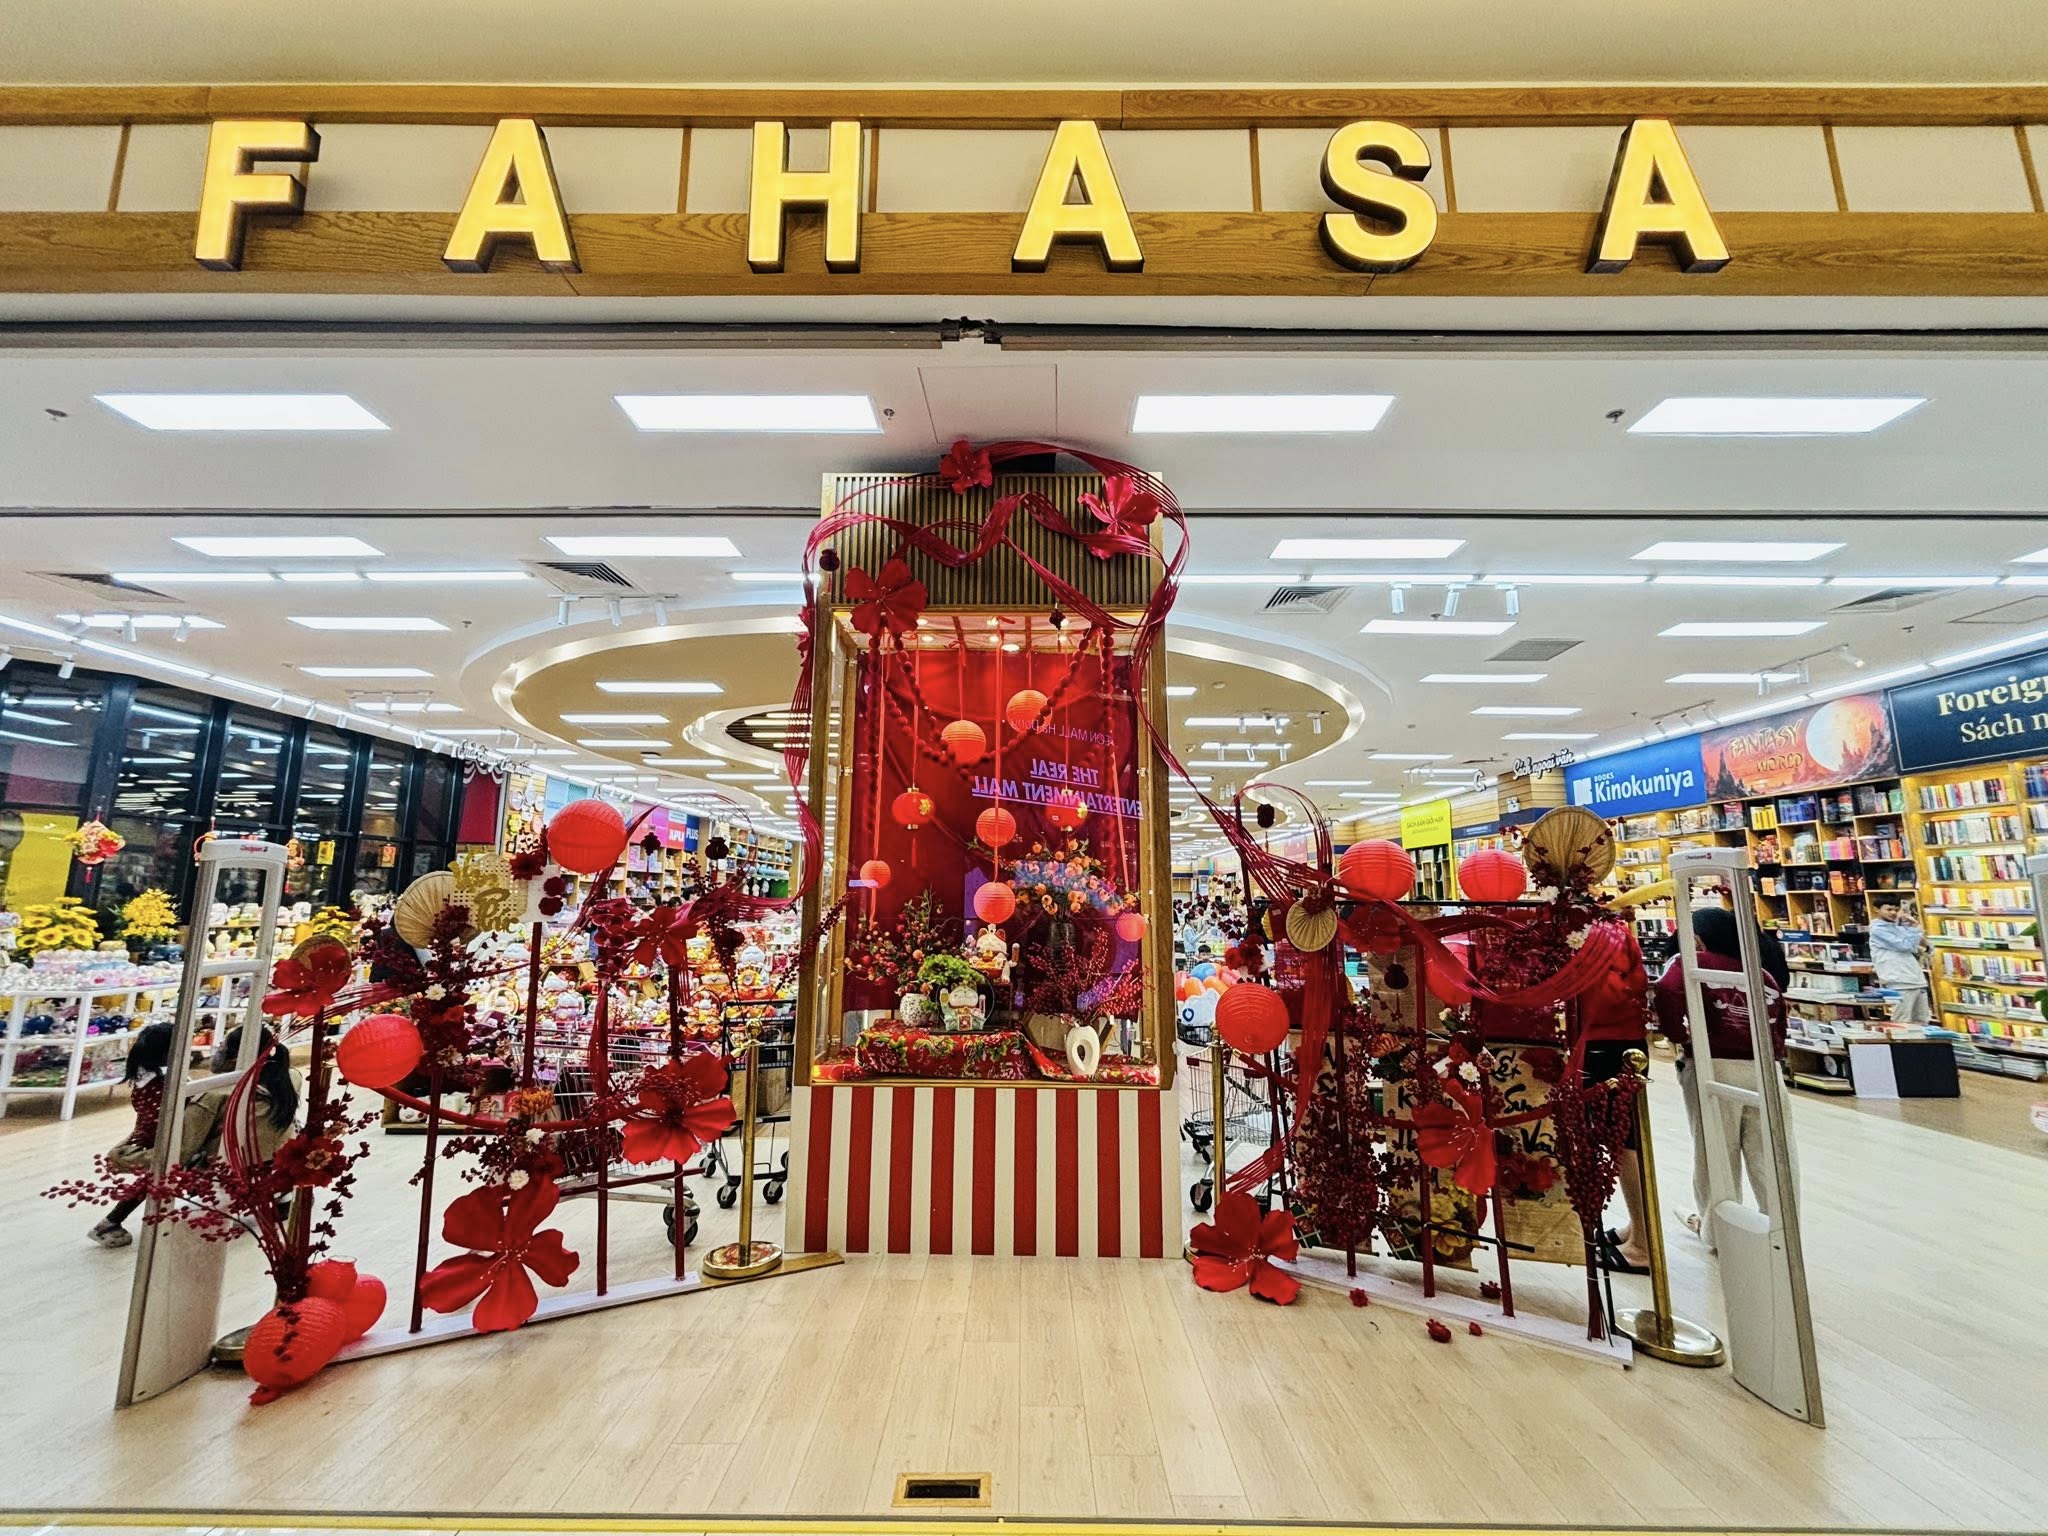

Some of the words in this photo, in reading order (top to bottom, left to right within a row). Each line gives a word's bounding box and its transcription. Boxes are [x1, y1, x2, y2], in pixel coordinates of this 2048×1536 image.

[194, 117, 1731, 271] FAHASA
[1728, 719, 1803, 759] FANTASY
[1960, 713, 2025, 743] Sách
[1593, 771, 1615, 783] BOOKS
[1757, 753, 1803, 772] WORLD
[1594, 767, 1695, 803] Kinokuniya
[686, 827, 699, 841] PLUS
